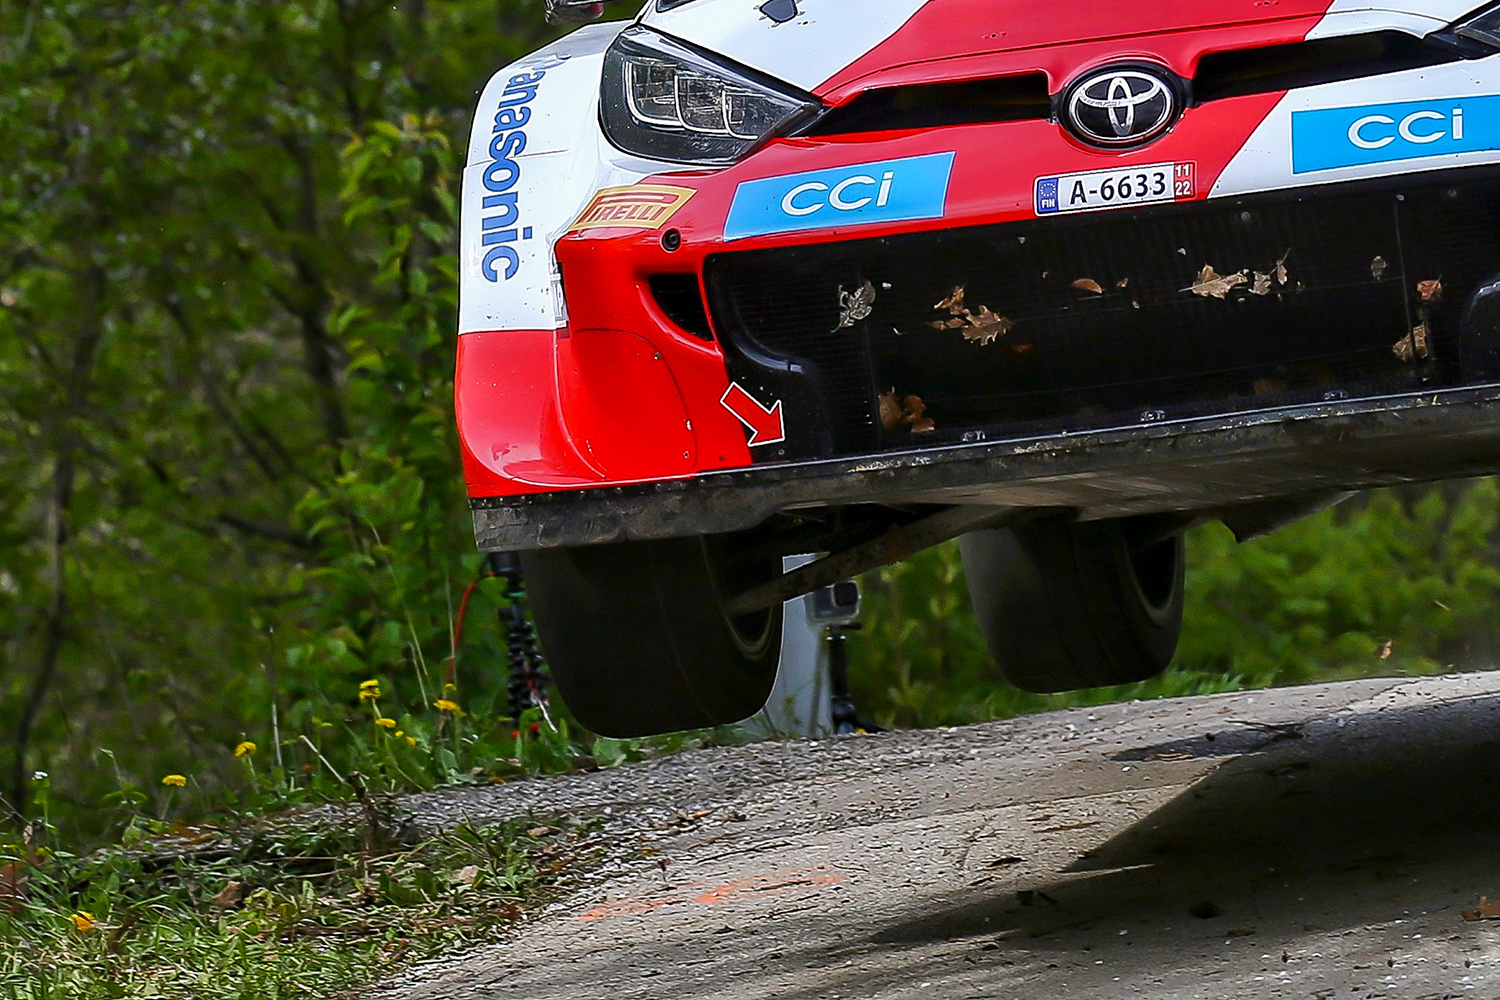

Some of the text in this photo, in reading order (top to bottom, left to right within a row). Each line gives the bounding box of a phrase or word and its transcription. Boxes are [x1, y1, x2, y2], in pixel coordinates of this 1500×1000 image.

[1174, 164, 1190, 177] 11
[1041, 171, 1167, 209] FIN A-6633
[1174, 180, 1191, 196] 22
[575, 191, 681, 225] PIRELLI
